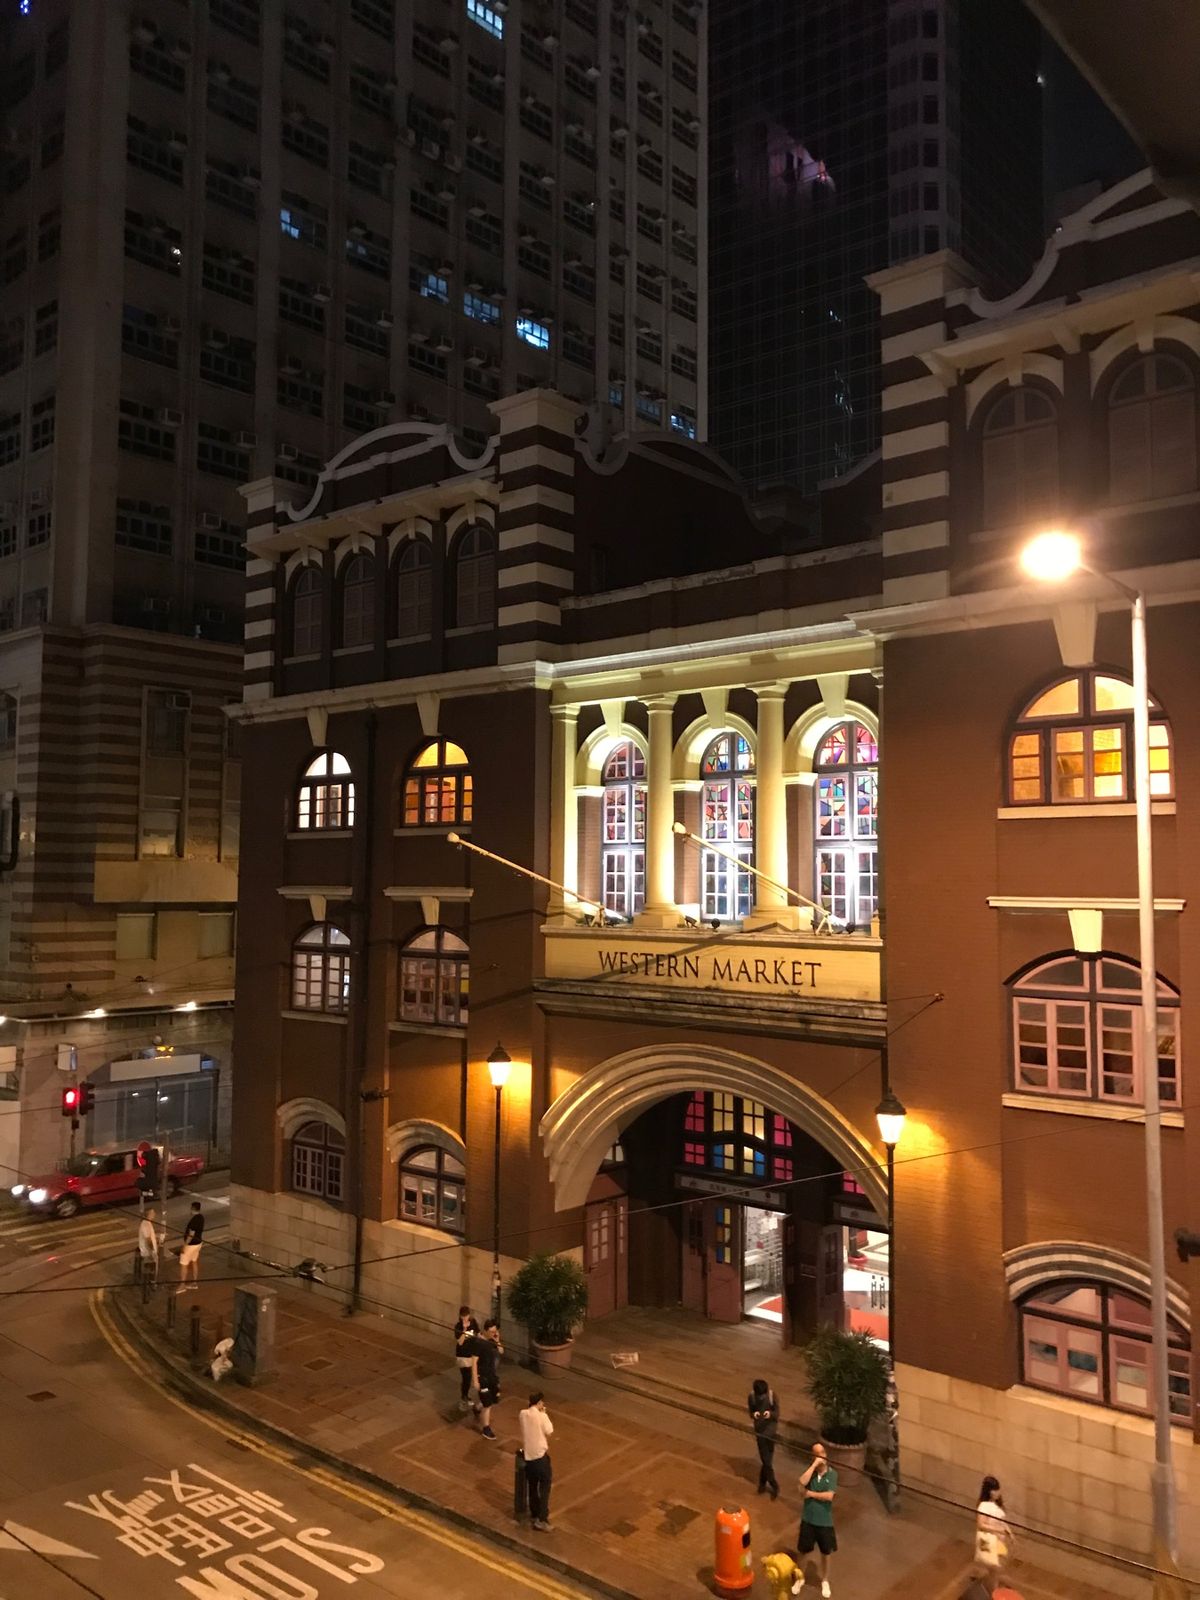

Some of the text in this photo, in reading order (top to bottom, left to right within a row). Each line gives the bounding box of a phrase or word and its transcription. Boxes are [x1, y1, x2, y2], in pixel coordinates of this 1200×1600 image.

[599, 951, 822, 987] WESTERN MARKET
[64, 1463, 298, 1566] 慢駛
